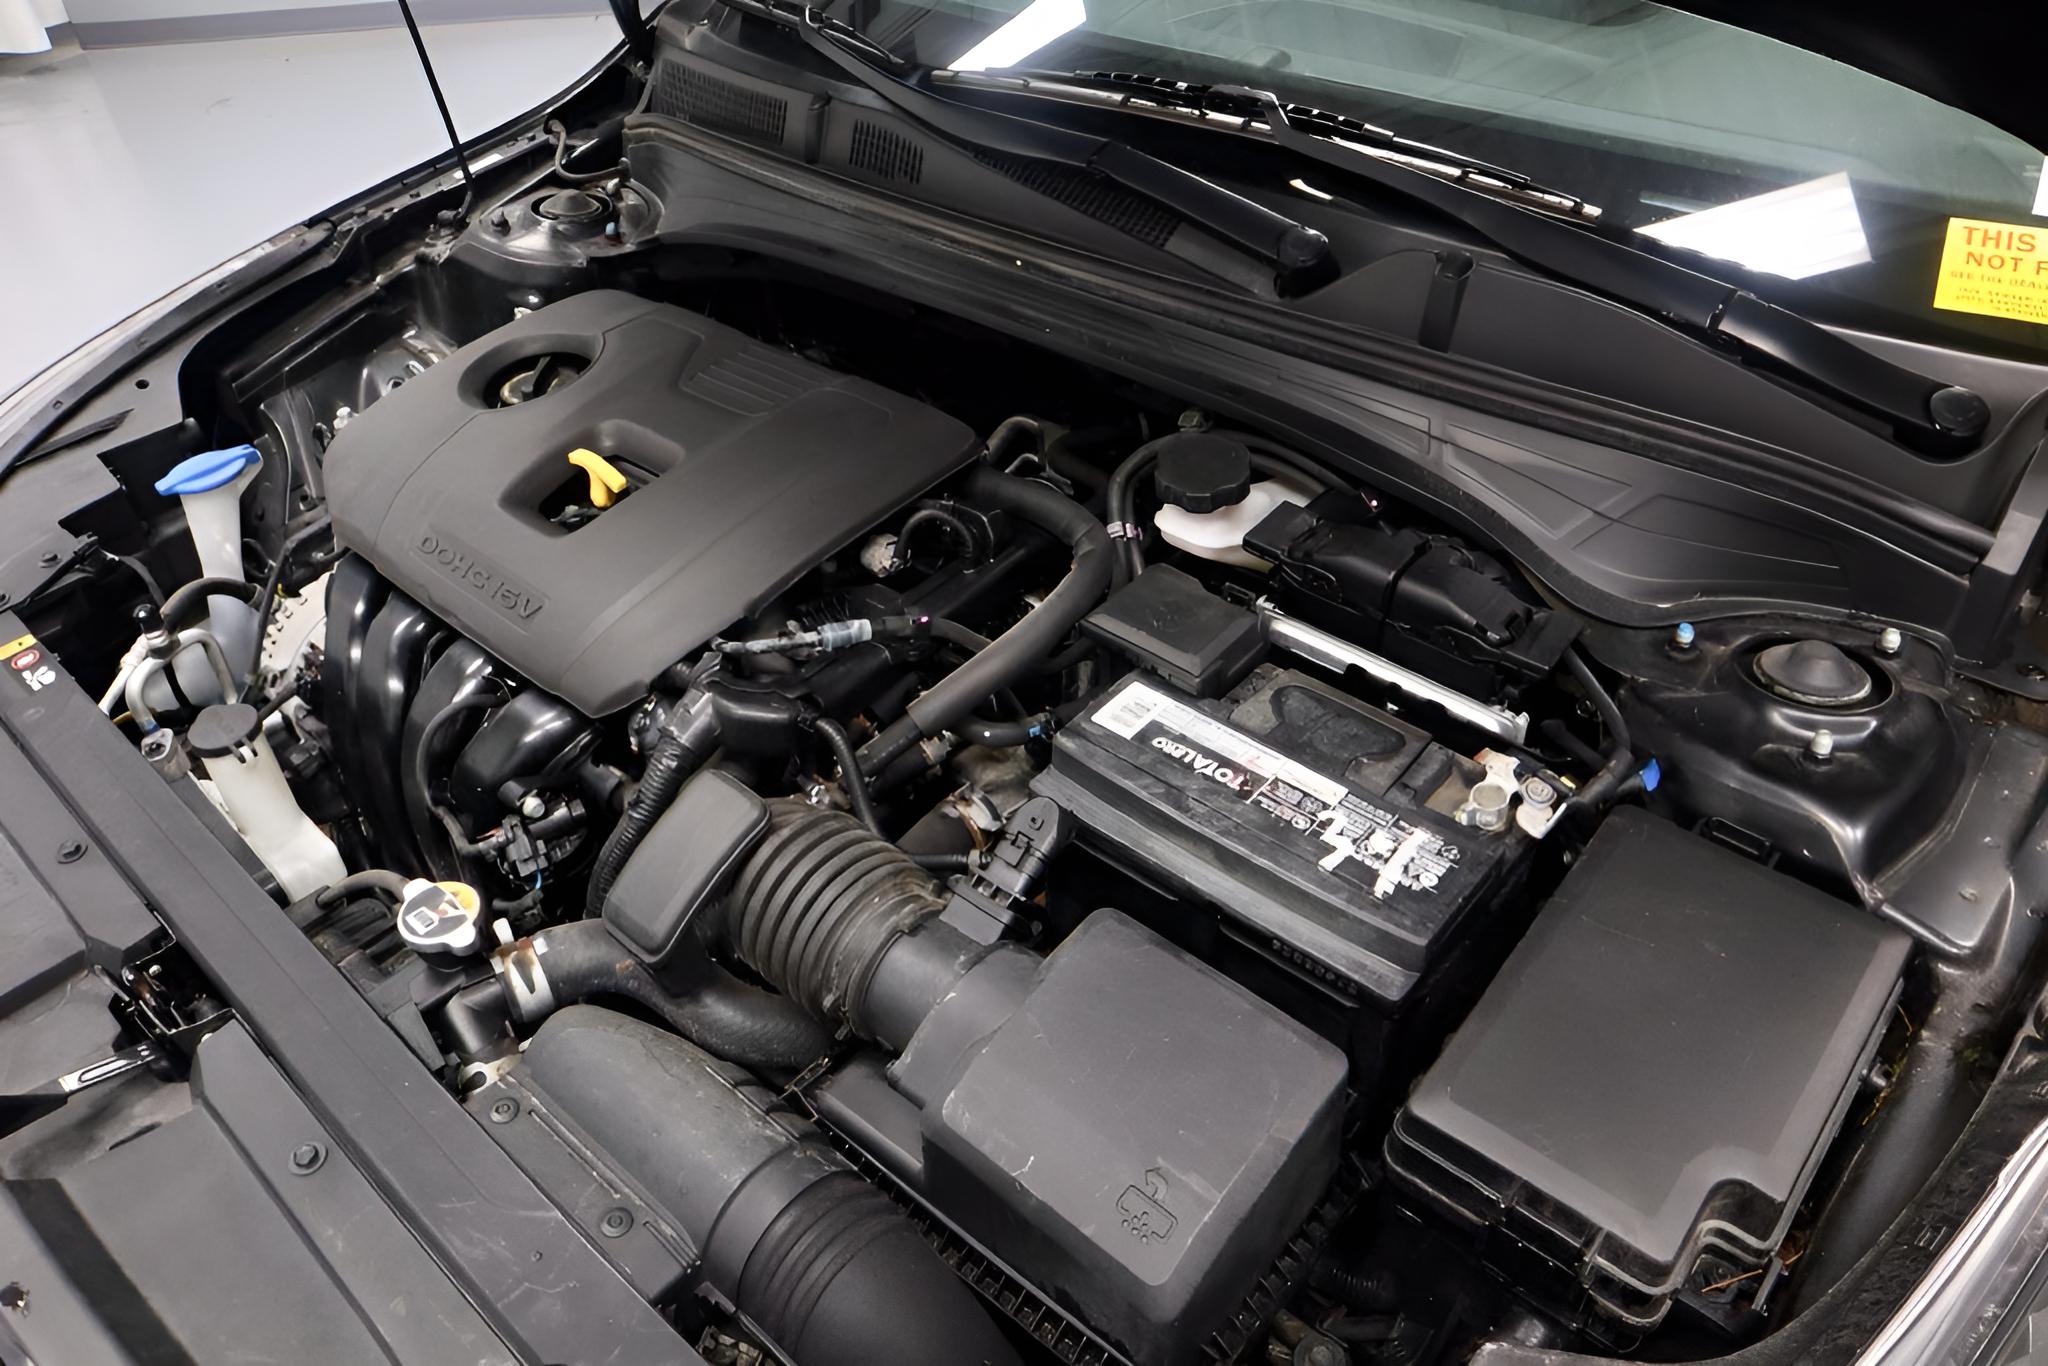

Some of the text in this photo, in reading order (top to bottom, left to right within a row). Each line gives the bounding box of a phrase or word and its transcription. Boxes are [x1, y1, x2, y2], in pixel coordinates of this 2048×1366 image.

[1963, 226, 2036, 252] THIS
[1966, 251, 2024, 273] NOT
[418, 536, 544, 620] DOHC 16V
